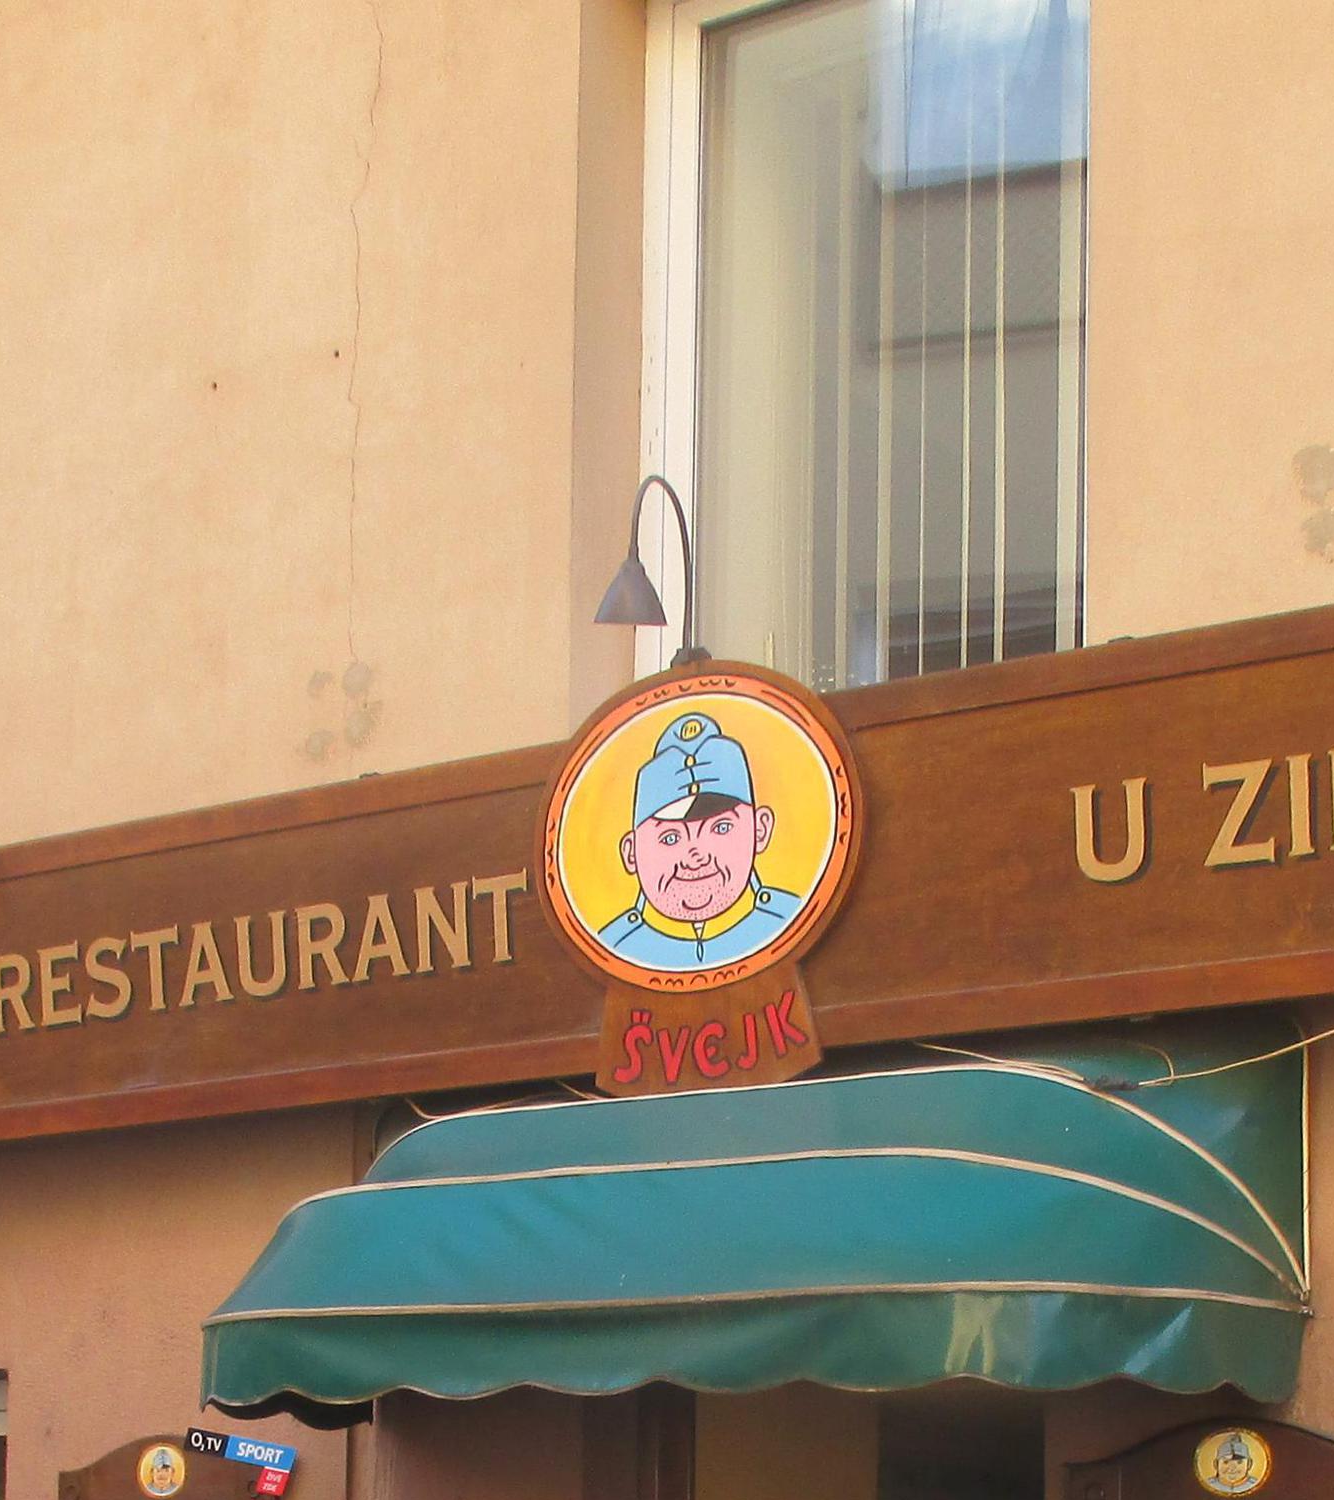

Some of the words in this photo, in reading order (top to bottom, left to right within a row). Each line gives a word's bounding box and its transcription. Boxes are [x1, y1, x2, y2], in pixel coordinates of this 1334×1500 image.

[1070, 777, 1146, 883] U
[614, 990, 808, 1084] ŠVEJK
[236, 1442, 284, 1464] SPORT
